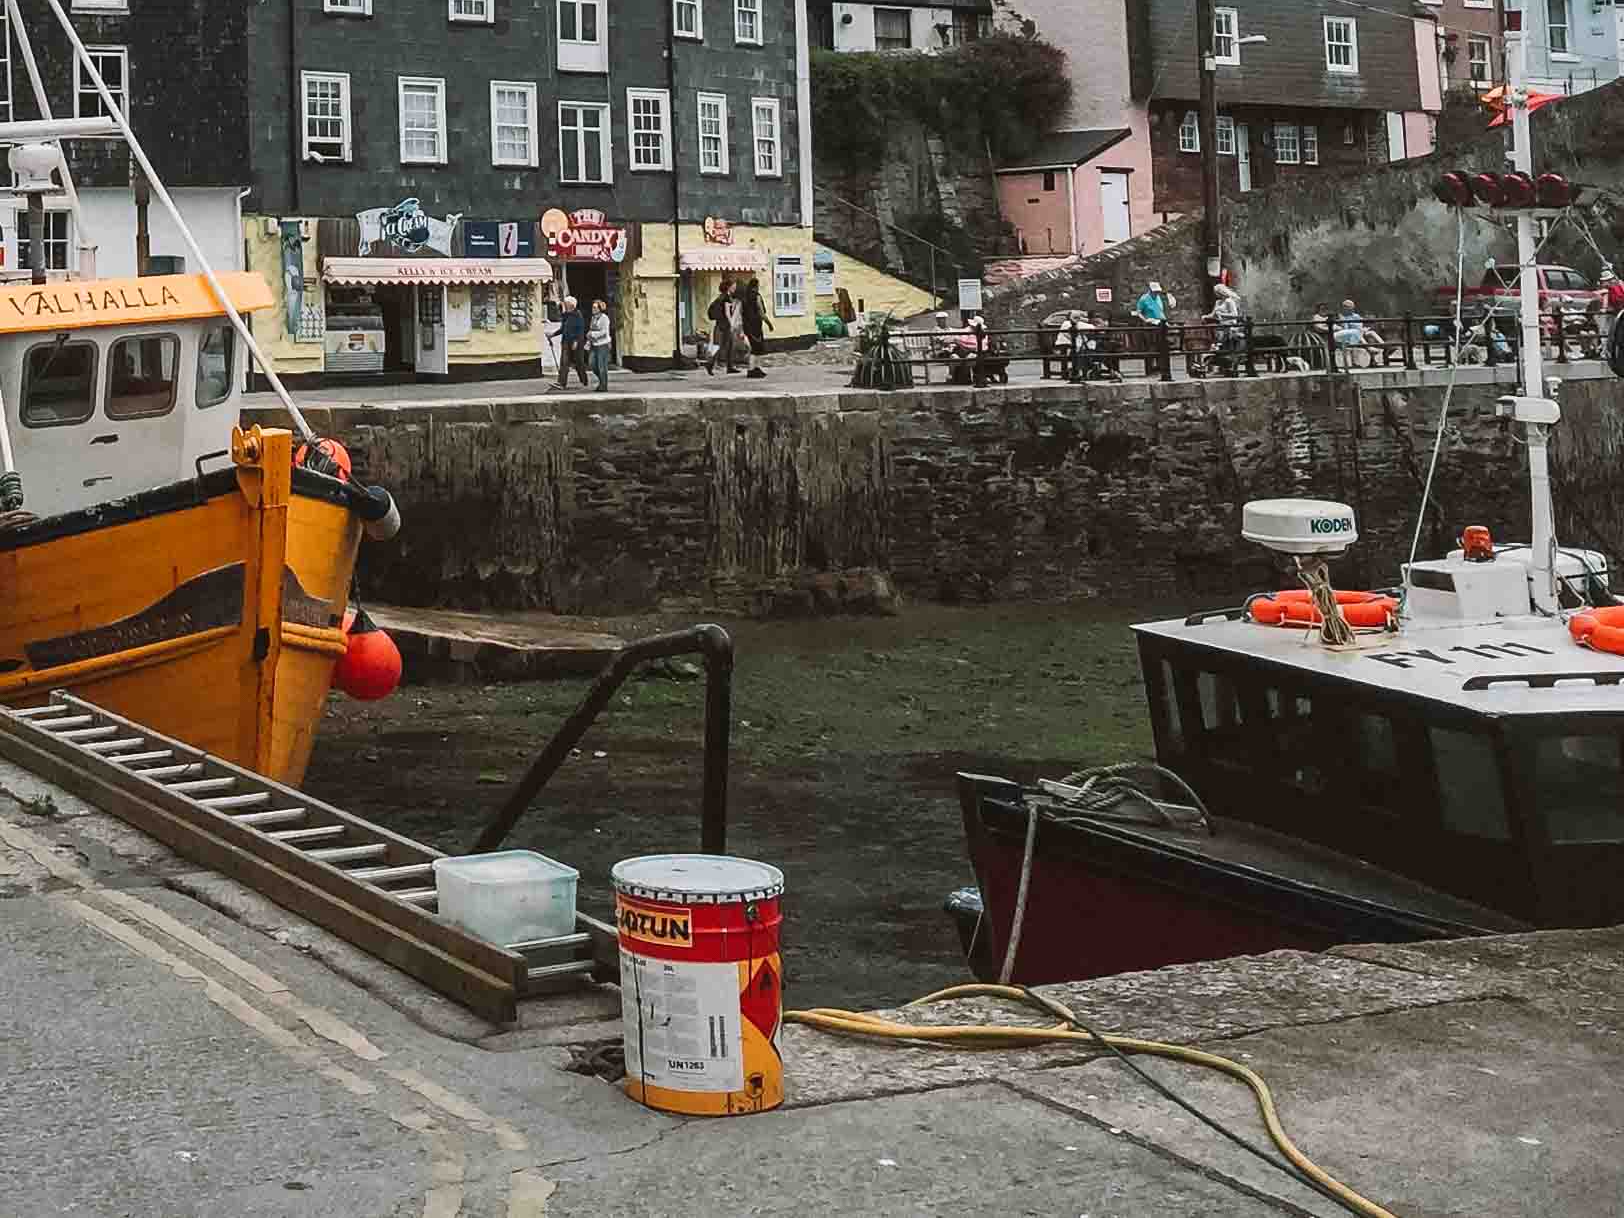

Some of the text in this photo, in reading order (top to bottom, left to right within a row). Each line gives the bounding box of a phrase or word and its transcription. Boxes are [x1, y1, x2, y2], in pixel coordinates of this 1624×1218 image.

[574, 209, 602, 224] THE
[558, 228, 617, 248] CANDY
[398, 267, 436, 276] KELLYS
[8, 285, 180, 315] VALHALLA
[1310, 517, 1353, 533] KODEN
[1363, 648, 1457, 668] FY
